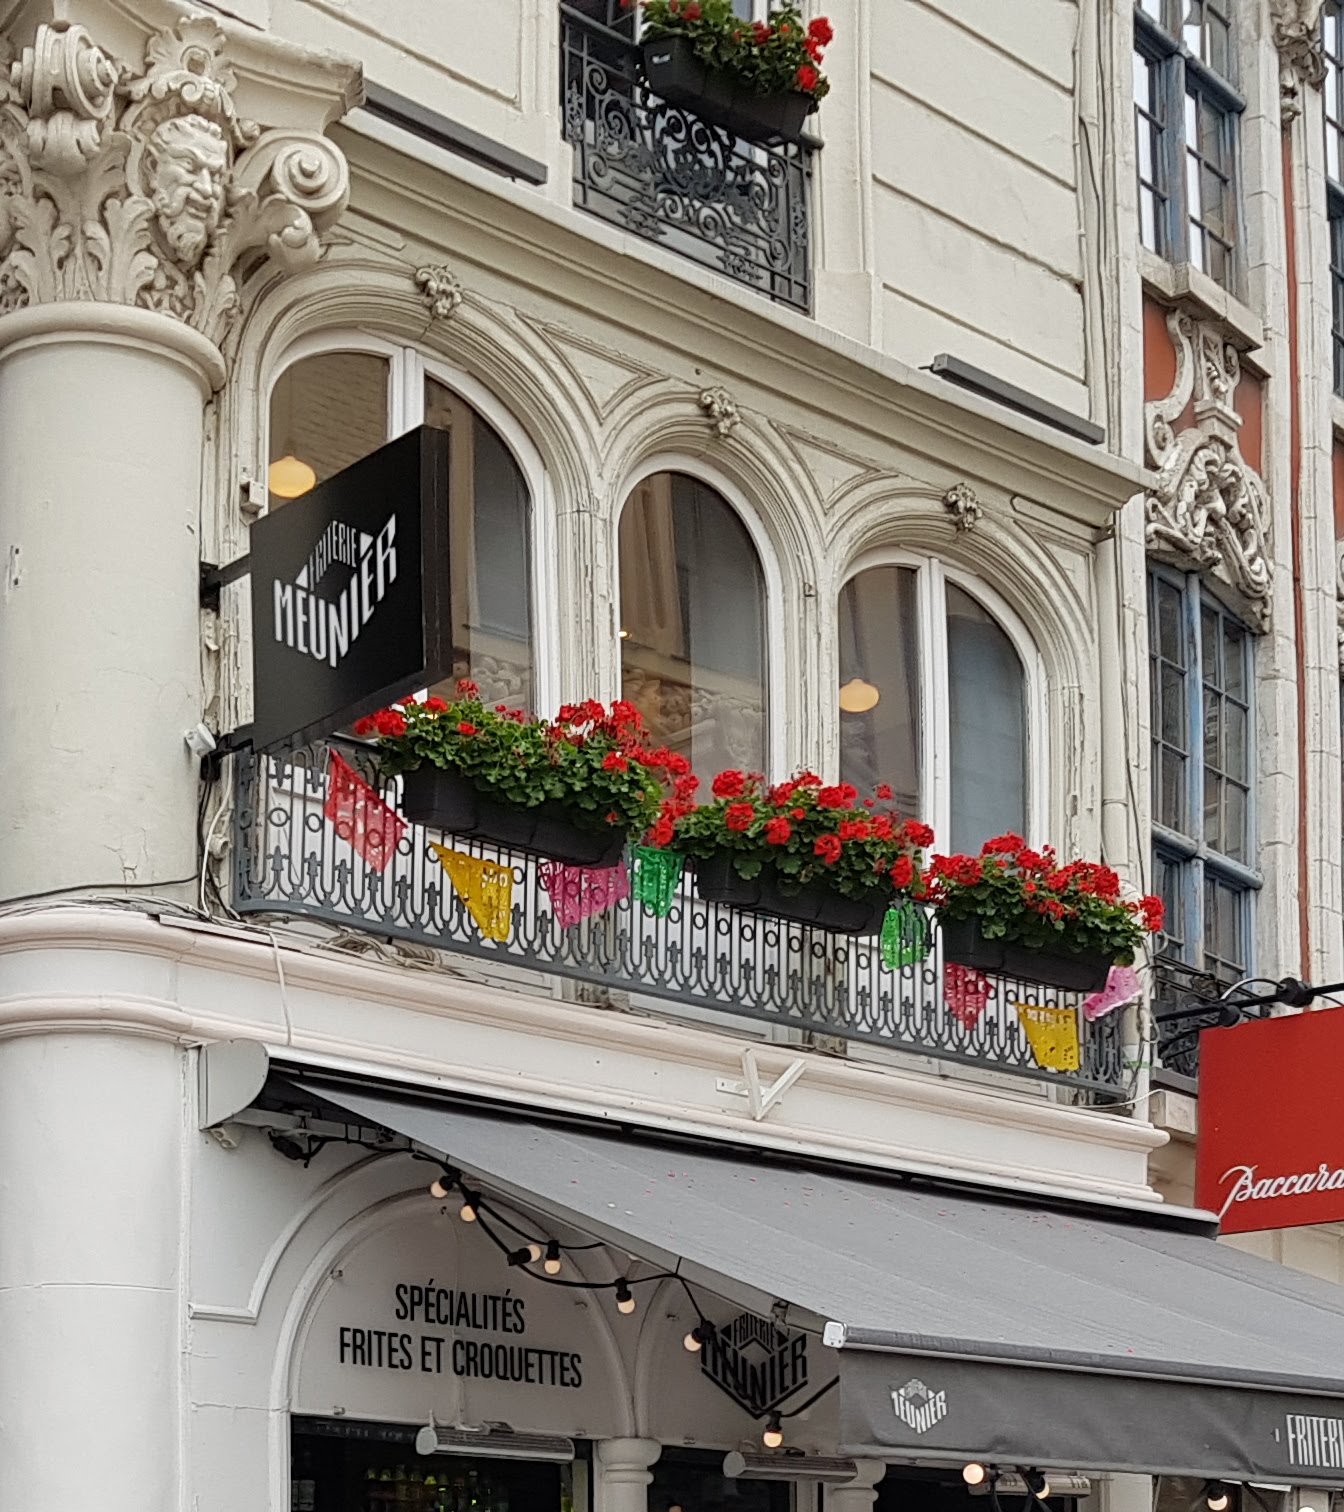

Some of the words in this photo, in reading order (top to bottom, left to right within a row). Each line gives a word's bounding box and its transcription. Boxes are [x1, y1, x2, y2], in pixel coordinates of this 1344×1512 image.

[309, 519, 357, 592] FRITERIE
[273, 512, 397, 668] MEUNIER
[394, 1278, 525, 1334] SPÉCIALITÉS
[339, 1326, 413, 1370] FRITES
[420, 1335, 446, 1374] ET
[452, 1339, 582, 1388] CROQUETTES
